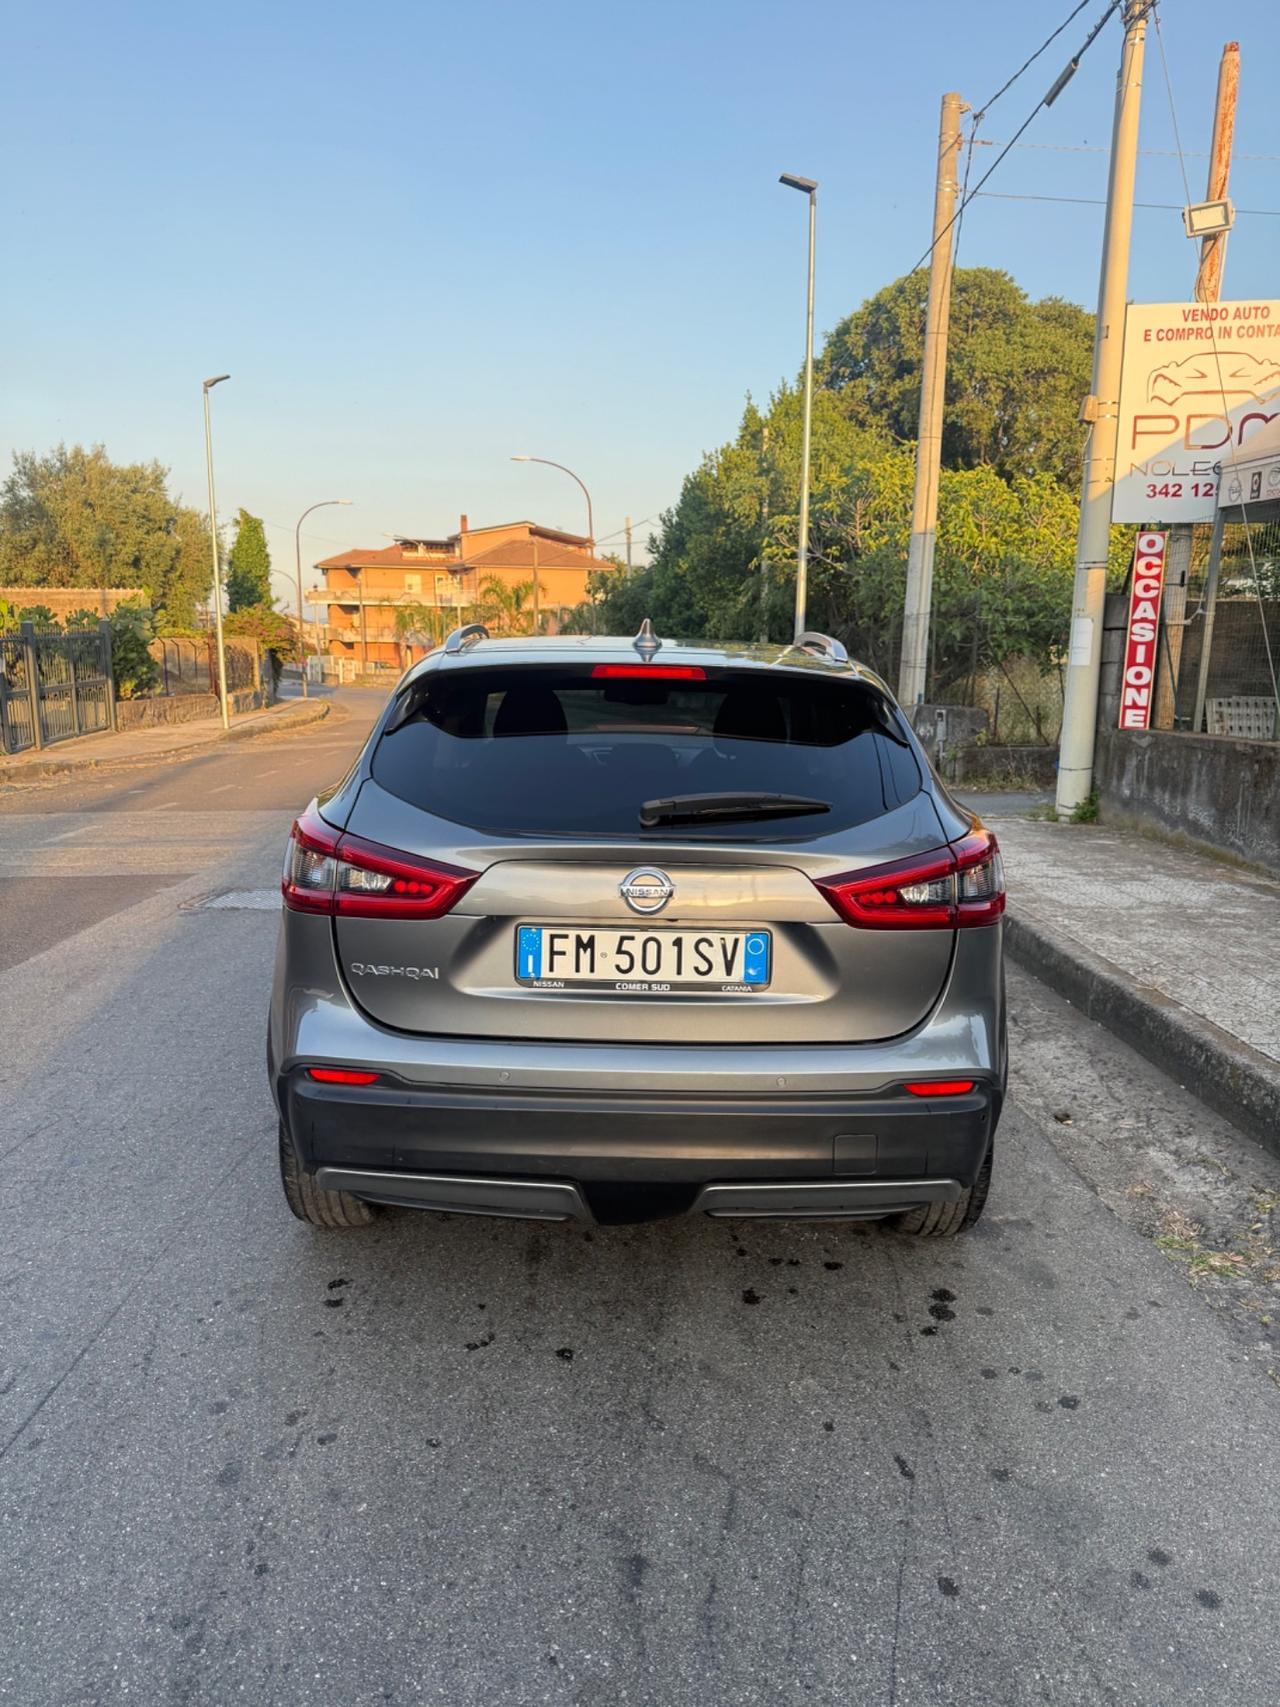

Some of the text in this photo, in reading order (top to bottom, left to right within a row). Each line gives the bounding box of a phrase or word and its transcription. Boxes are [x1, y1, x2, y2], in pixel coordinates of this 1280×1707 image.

[1182, 306, 1270, 322] VENDO AUTO
[1143, 328, 1152, 342] E
[1156, 326, 1213, 341] COMPRO
[1218, 326, 1232, 339] IN
[1146, 483, 1183, 498] 342
[1191, 482, 1219, 498] 12
[1124, 534, 1164, 728] OCCASIONE
[626, 887, 669, 896] NISSAN
[350, 962, 439, 980] QASHQAI
[615, 982, 671, 991] COMER SUD
